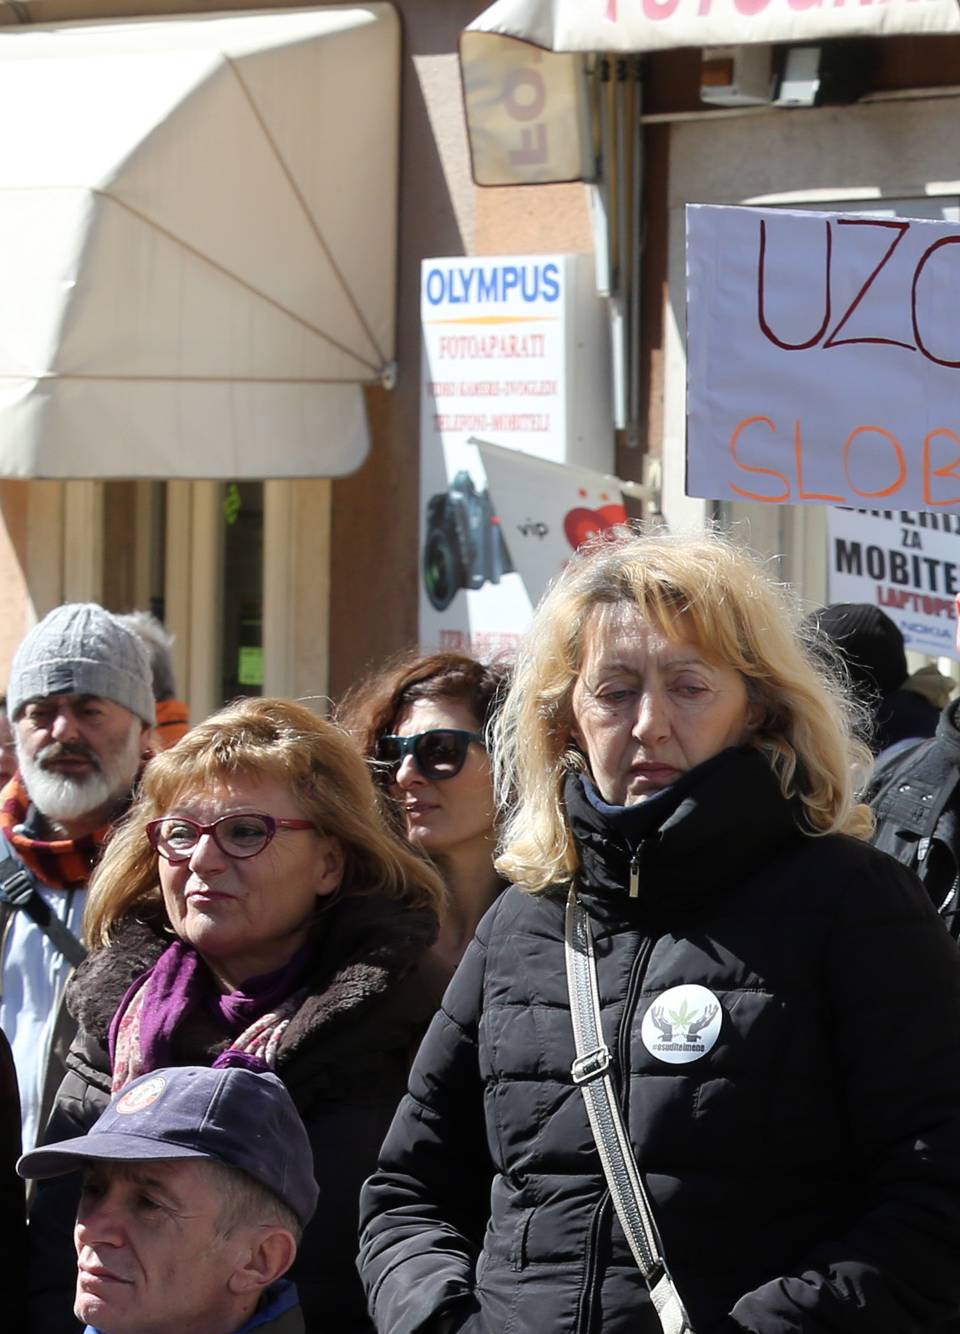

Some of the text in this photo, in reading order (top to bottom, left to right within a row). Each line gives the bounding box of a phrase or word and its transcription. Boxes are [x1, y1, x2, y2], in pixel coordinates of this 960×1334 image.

[426, 263, 561, 305] OLYMPUS
[438, 333, 546, 359] FOTOAPARATI
[517, 518, 549, 541] vip
[901, 528, 922, 549] ZA
